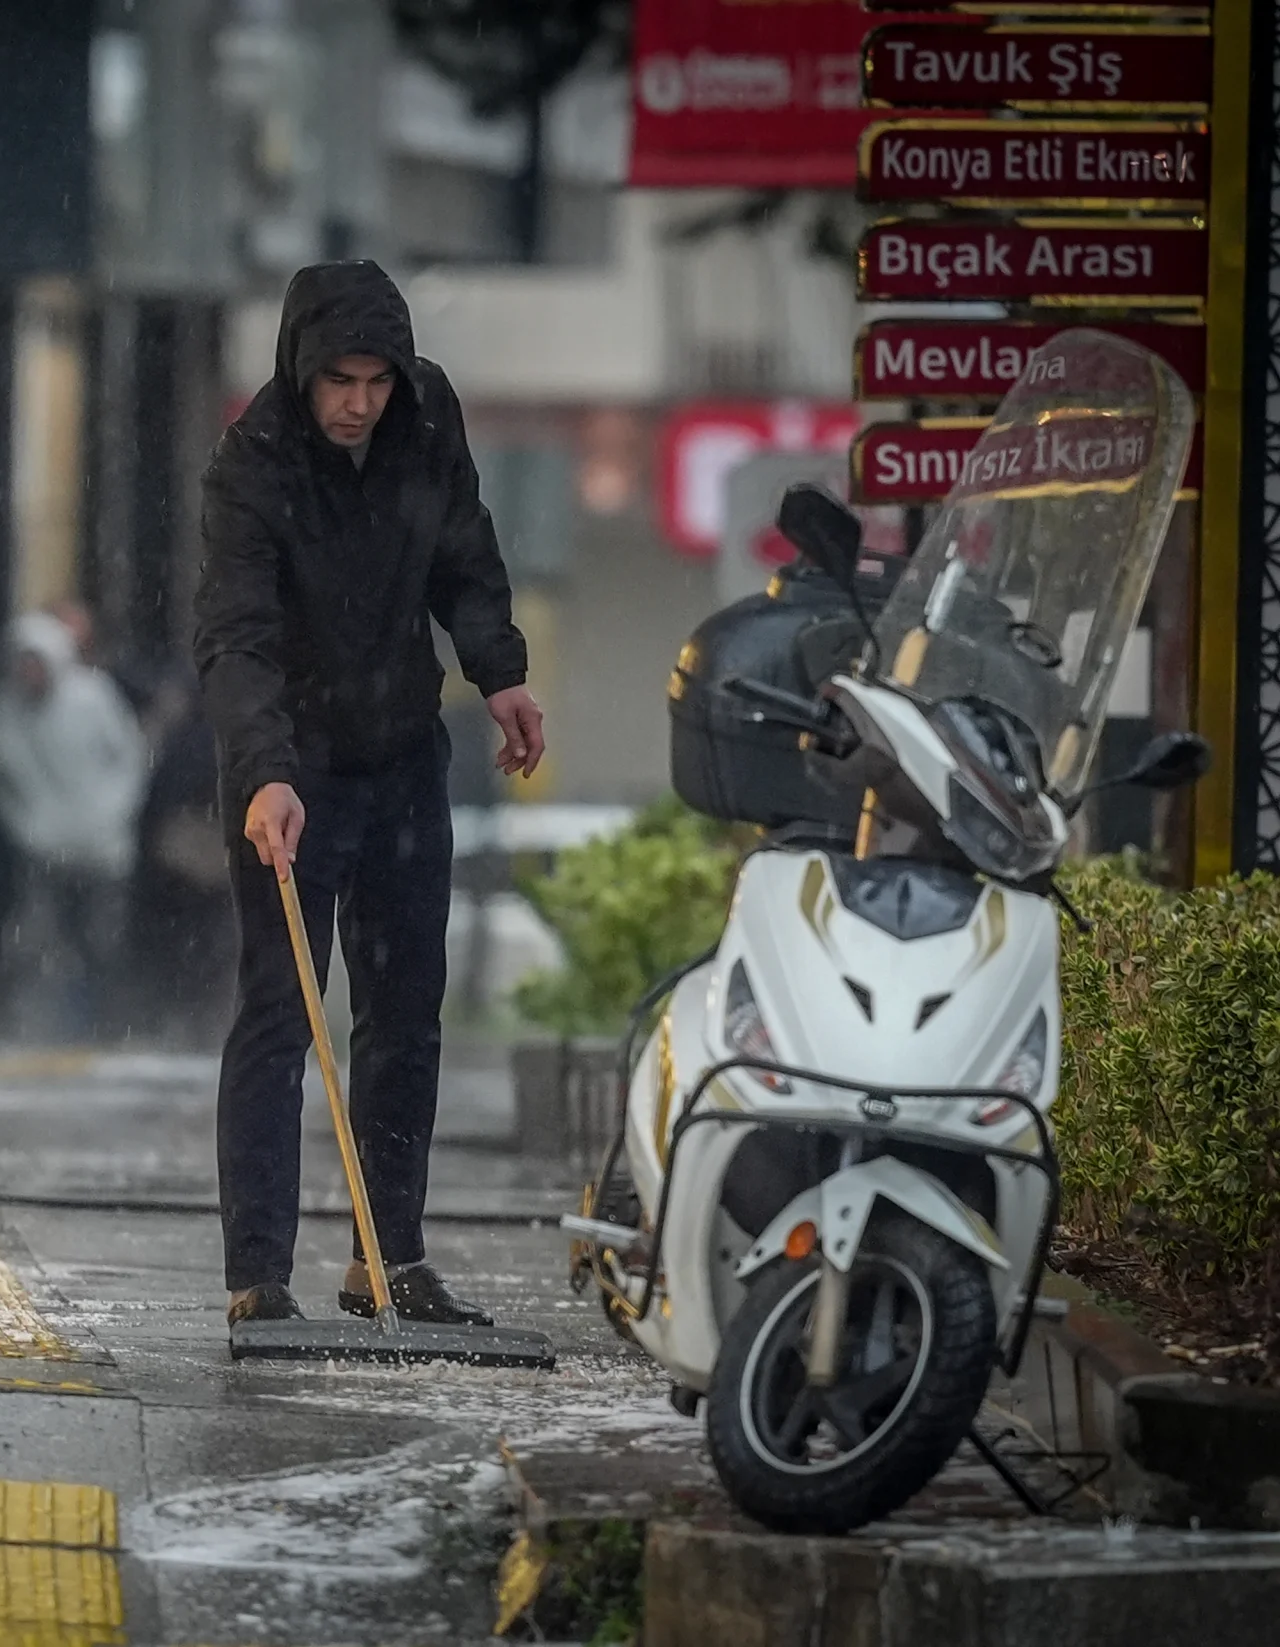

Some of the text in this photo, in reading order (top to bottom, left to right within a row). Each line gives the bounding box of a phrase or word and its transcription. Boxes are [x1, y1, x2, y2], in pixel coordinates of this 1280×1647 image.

[885, 41, 1034, 83] Tavuk
[1048, 40, 1123, 96] Şiş
[881, 138, 1196, 190] Konya Etli Ekmek
[879, 234, 1153, 288] Bıçak Arası
[874, 335, 1066, 385] Mevlana
[876, 442, 1023, 487] Sınırsız
